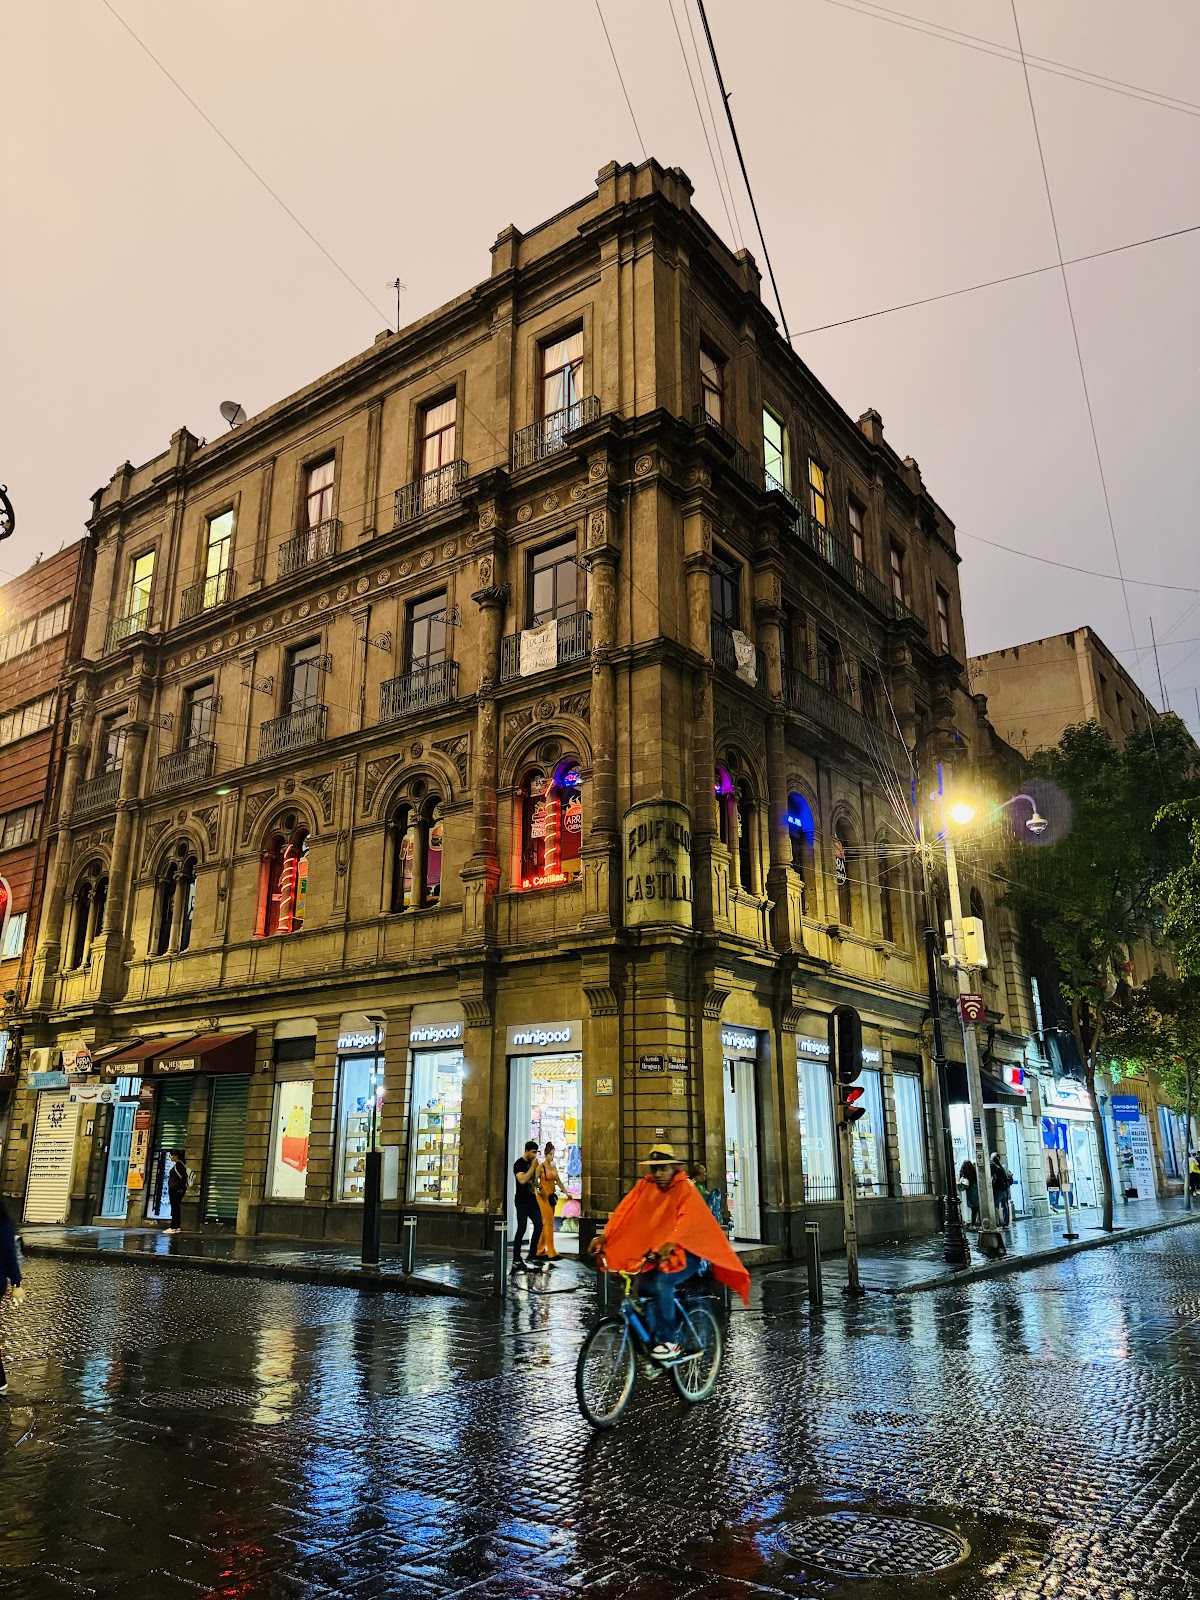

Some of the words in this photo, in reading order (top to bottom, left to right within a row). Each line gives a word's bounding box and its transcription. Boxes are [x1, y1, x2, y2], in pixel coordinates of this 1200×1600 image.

[628, 819, 692, 860] EDIFICIO
[533, 873, 567, 887] Costillas,
[409, 1024, 460, 1043] minigood
[513, 1027, 570, 1046] minigood
[721, 1031, 755, 1050] minigood
[861, 1048, 879, 1063] igood
